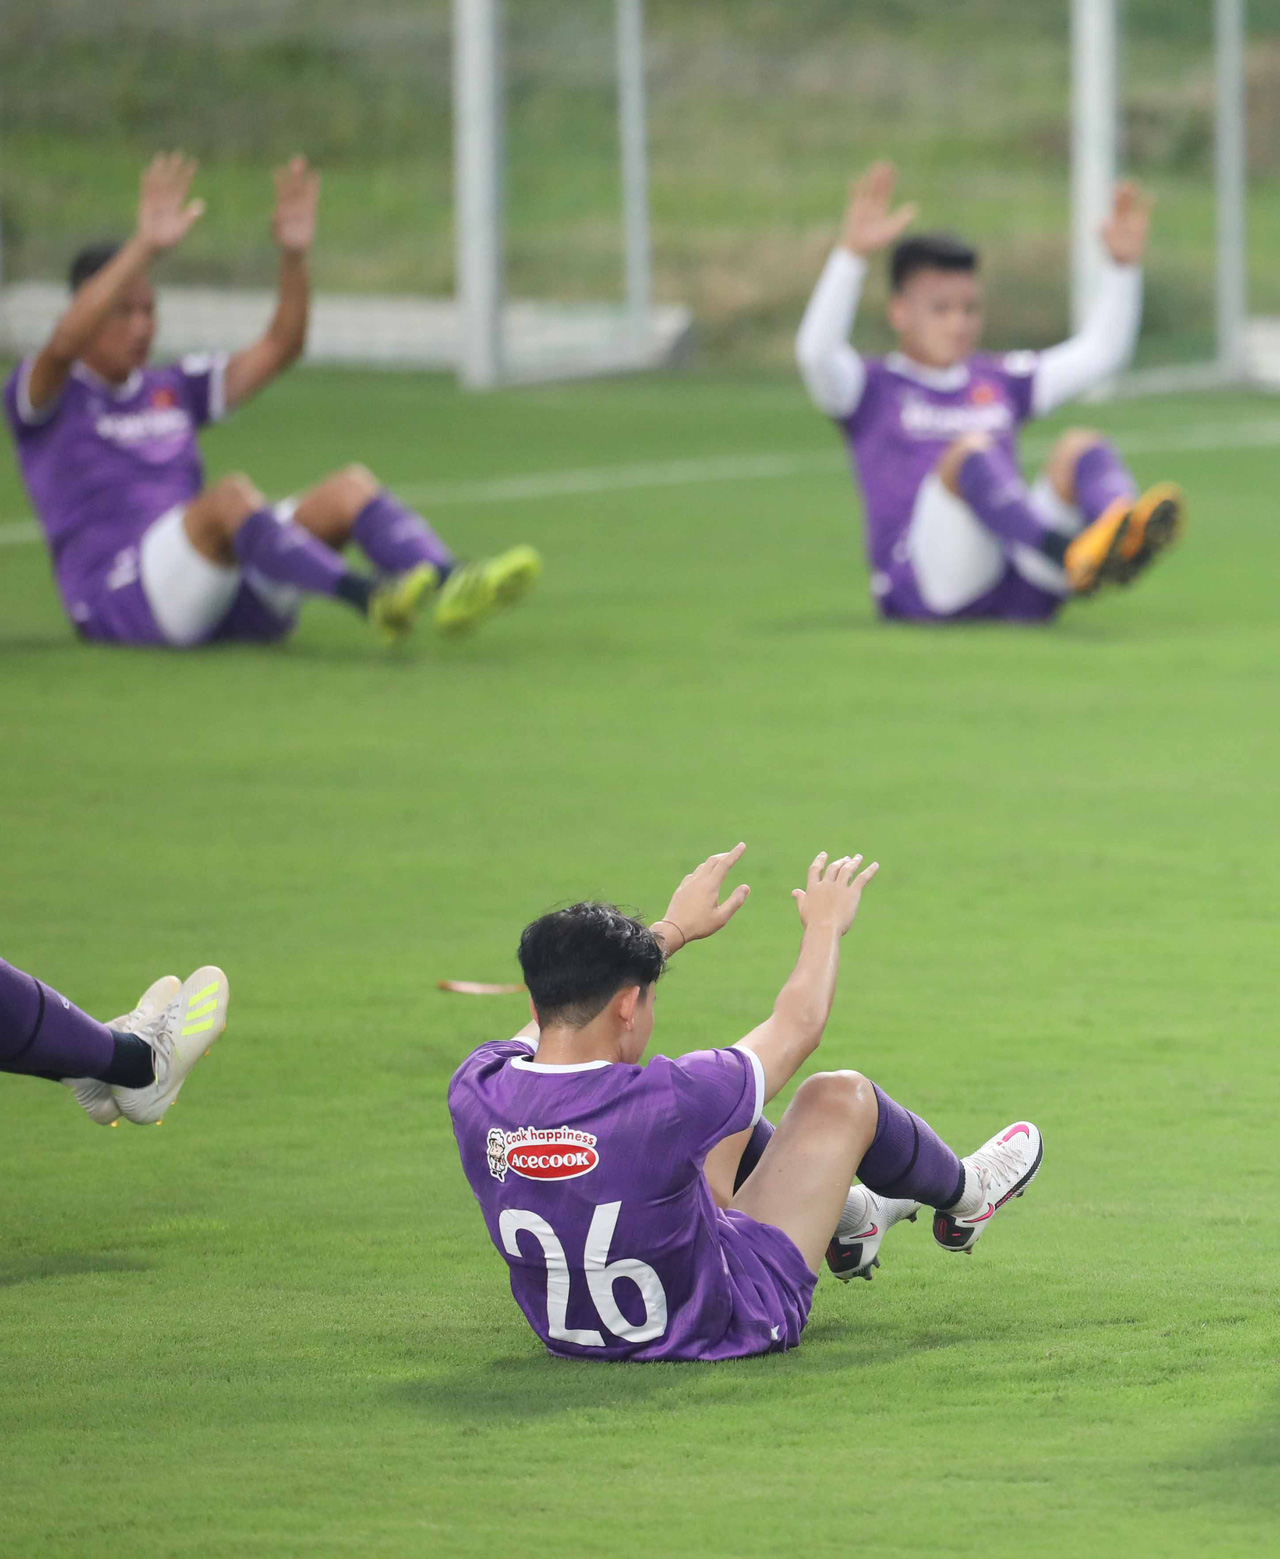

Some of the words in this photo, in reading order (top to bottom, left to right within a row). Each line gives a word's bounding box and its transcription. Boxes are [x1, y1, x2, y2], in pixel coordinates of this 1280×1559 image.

[506, 1129, 527, 1144] Cook
[530, 1129, 594, 1145] happiness
[499, 1201, 668, 1346] 26
